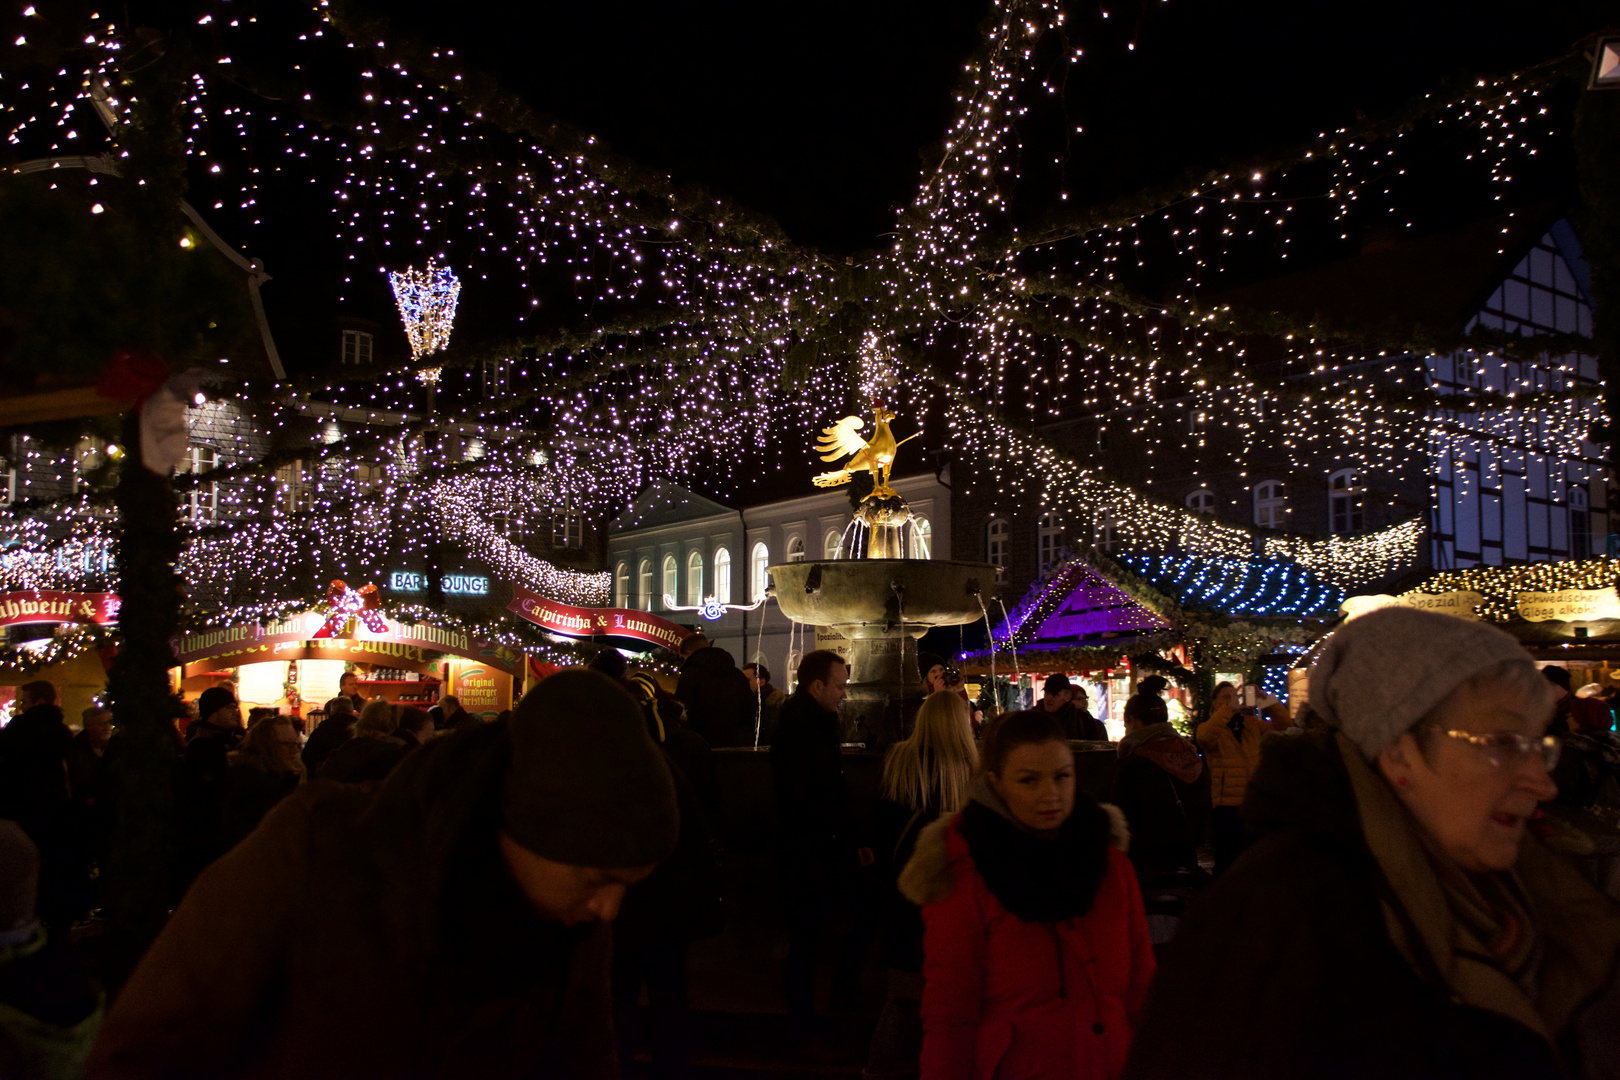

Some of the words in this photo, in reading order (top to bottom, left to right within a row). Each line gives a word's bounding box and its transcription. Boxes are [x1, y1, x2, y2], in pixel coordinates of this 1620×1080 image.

[395, 574, 421, 588] BAR
[441, 576, 488, 591] OUNGE
[1408, 594, 1460, 609] Spezial
[1520, 592, 1600, 604] Schwedischer
[79, 600, 96, 617] &
[1522, 607, 1554, 619] Glögg
[1559, 604, 1597, 615] alkoho
[521, 598, 591, 630] Caipirinha
[597, 615, 608, 627] &
[614, 614, 683, 647] Lumumba
[463, 678, 495, 688] Original
[456, 686, 497, 697] Nürnberger
